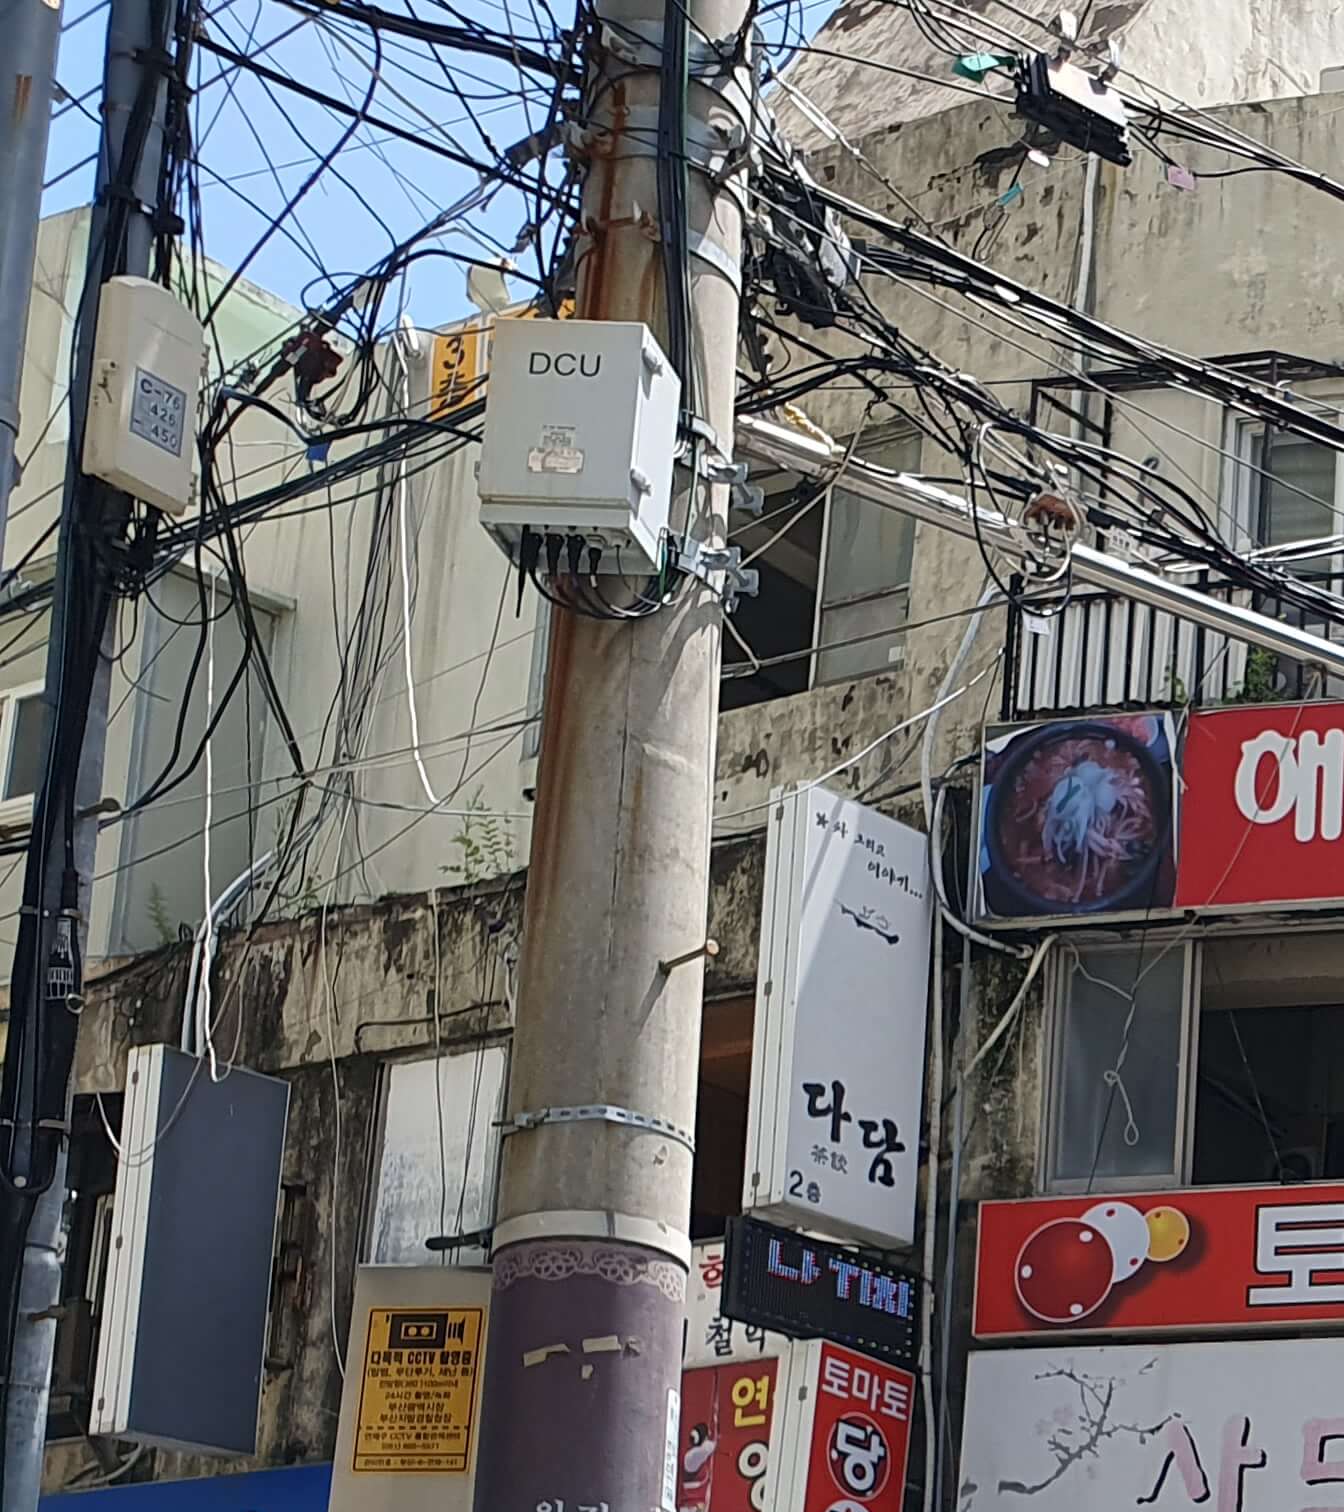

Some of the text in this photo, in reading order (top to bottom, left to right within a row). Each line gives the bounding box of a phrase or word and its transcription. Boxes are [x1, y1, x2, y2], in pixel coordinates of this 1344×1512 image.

[529, 352, 602, 377] DCU
[151, 424, 178, 449] 450
[802, 1080, 906, 1187] 다담
[407, 1351, 436, 1365] CCTV
[822, 1355, 909, 1421] 토마토
